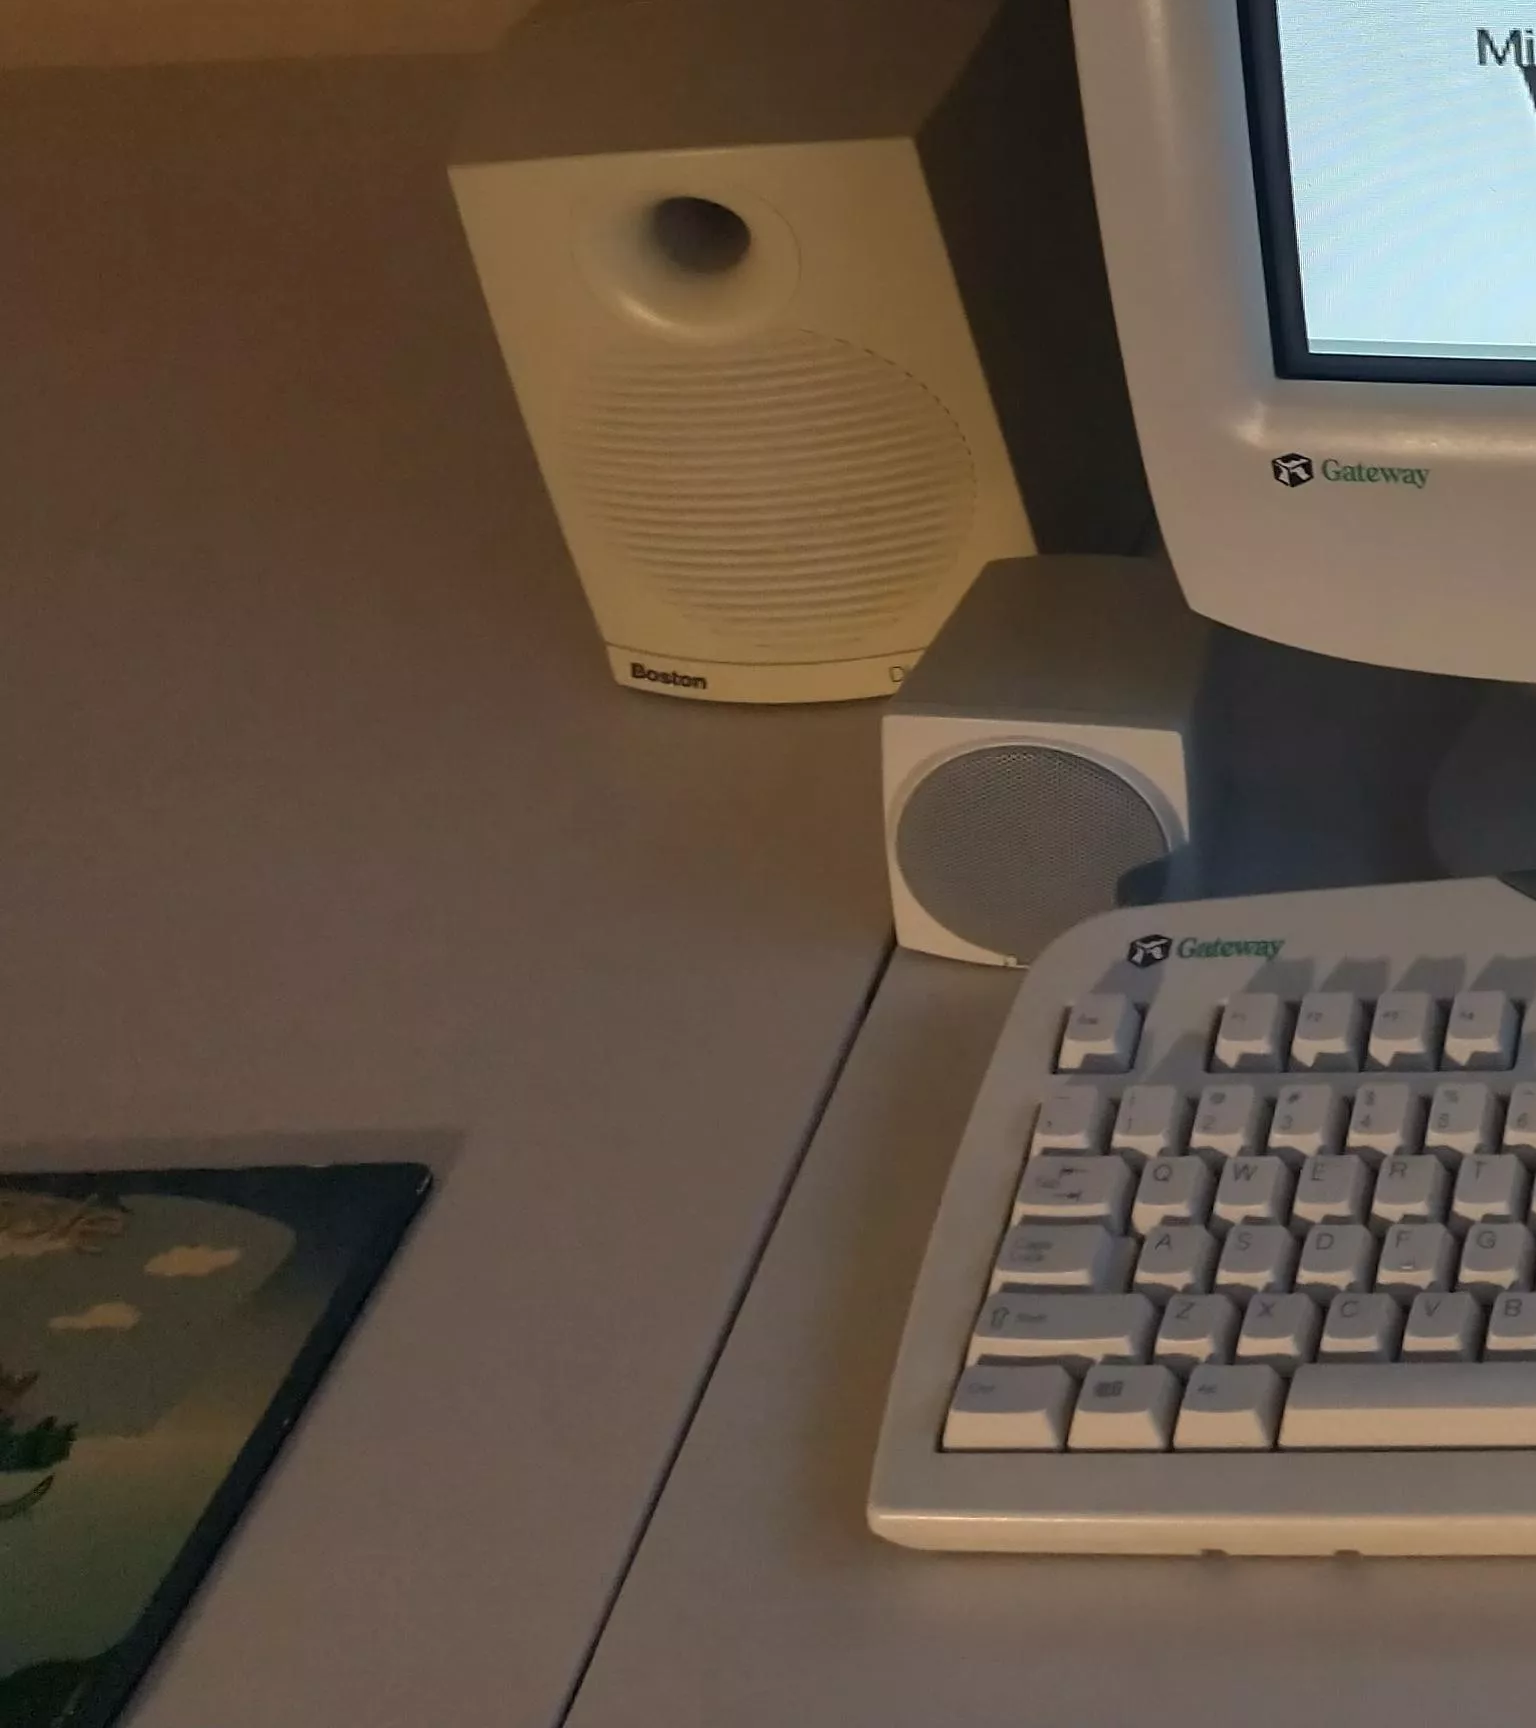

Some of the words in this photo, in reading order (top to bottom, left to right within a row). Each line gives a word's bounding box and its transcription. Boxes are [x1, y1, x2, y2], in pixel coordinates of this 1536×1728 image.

[1321, 458, 1431, 490] Gateway
[630, 661, 708, 690] Boston
[1176, 936, 1286, 963] Gateway
[1152, 1162, 1174, 1182] Q
[1232, 1162, 1259, 1182] W
[1310, 1161, 1326, 1182] E
[1388, 1159, 1409, 1179] R
[1474, 1159, 1489, 1181] T
[1153, 1232, 1174, 1252] A
[1233, 1232, 1254, 1252] S
[1314, 1231, 1336, 1251] D
[1394, 1229, 1412, 1249] F
[1474, 1229, 1498, 1250] G
[1173, 1300, 1197, 1321] Z
[1255, 1300, 1277, 1319] X
[1339, 1299, 1360, 1319] C
[1422, 1299, 1442, 1319] V
[1503, 1298, 1524, 1318] B
